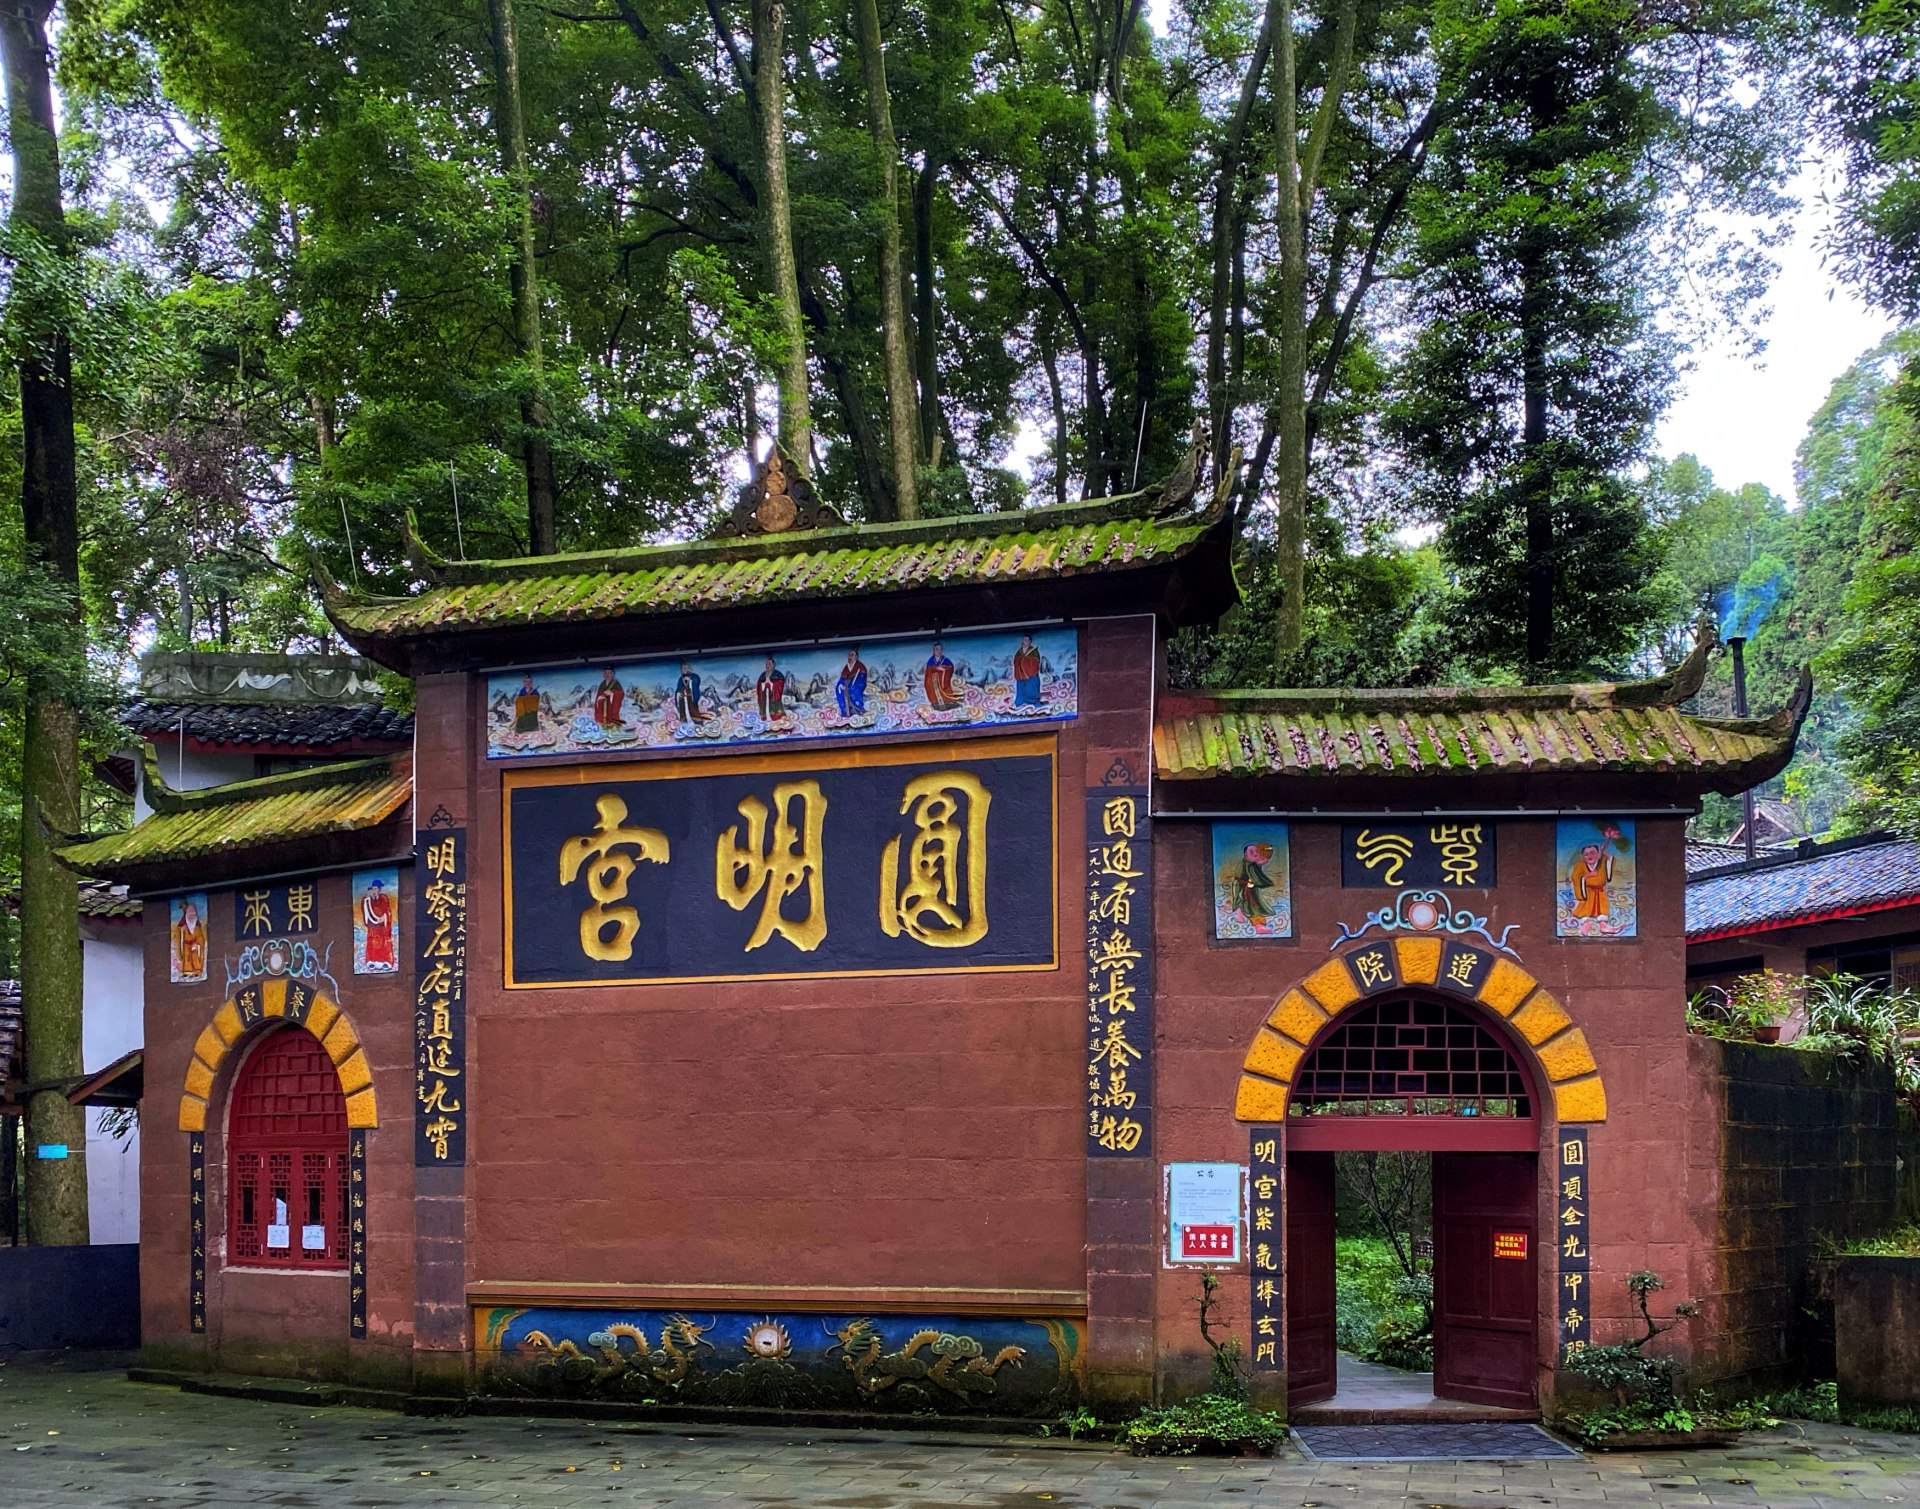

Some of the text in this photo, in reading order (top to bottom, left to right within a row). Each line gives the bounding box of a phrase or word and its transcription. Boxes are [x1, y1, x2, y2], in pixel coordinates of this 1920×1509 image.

[559, 770, 992, 962] 圓明宮
[1355, 951, 1478, 988] 道院
[1254, 1139, 1280, 1365] 明宮紫氣捧玄門
